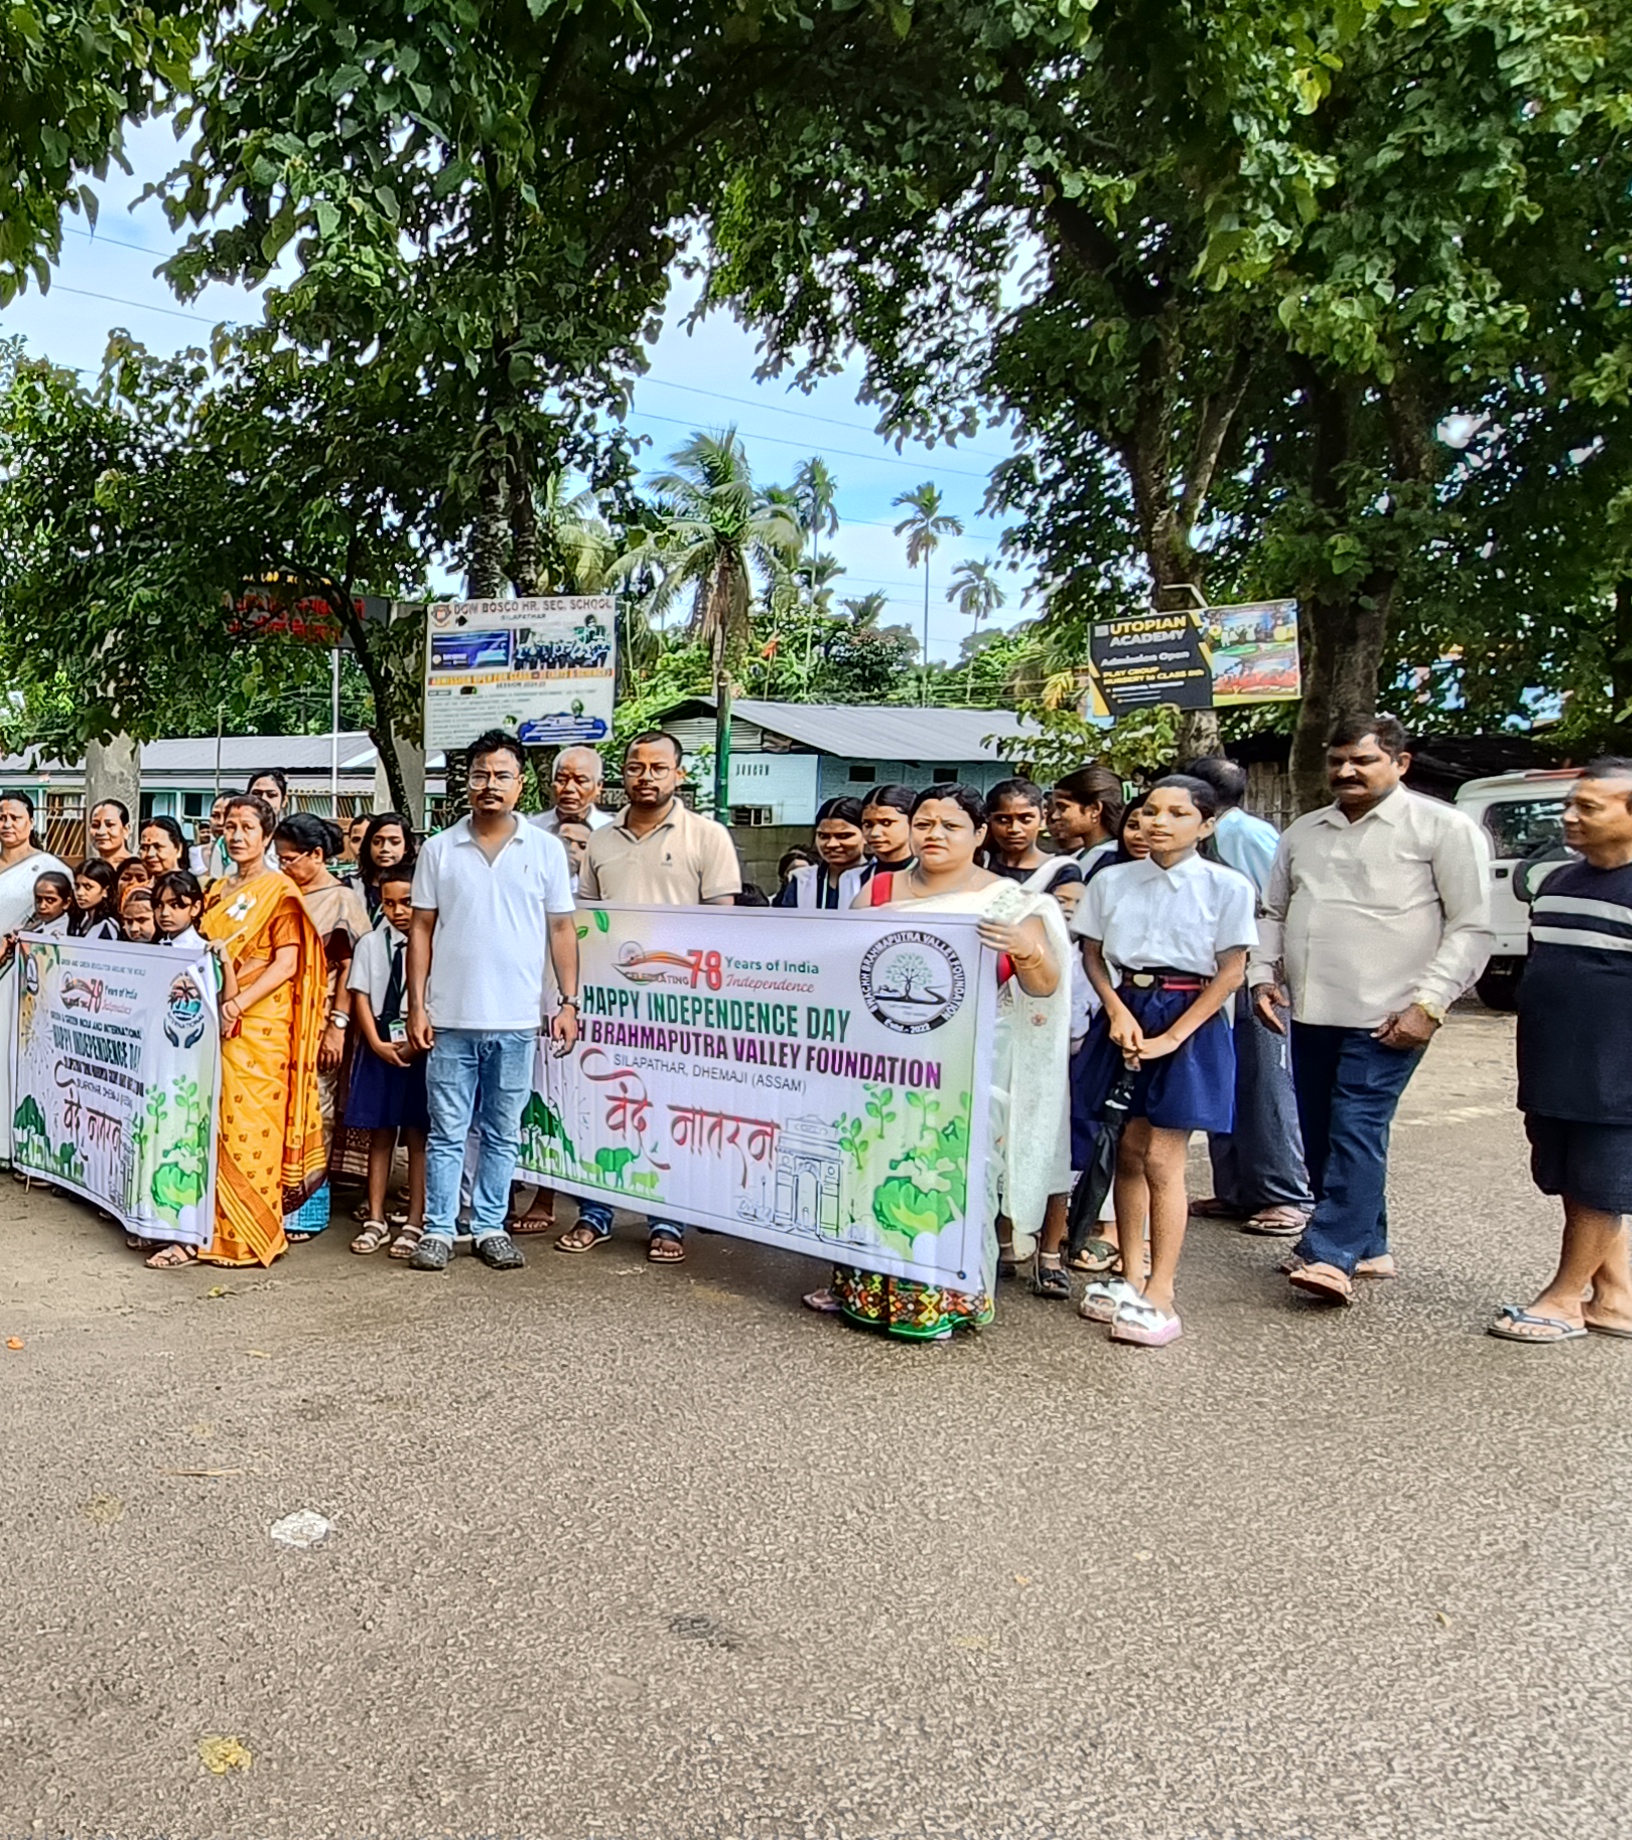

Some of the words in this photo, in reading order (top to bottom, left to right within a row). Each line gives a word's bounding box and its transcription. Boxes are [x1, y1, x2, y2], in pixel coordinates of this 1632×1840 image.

[454, 602, 479, 615] DON
[482, 601, 519, 613] BOSCO
[523, 601, 539, 611] HR.
[543, 600, 567, 611] SEC.
[570, 598, 612, 610] SCHOOL
[1110, 616, 1186, 635] UTOPIAN
[1109, 629, 1186, 647] ACADEMY
[1100, 653, 1158, 667] Admission
[1159, 651, 1190, 661] Open
[1103, 669, 1127, 678] PLAY
[1128, 666, 1160, 675] GROUP
[1103, 675, 1145, 685] NURSERY
[1157, 670, 1187, 680] CLASS
[686, 949, 723, 991] 78
[725, 956, 762, 971] Years
[766, 959, 780, 972] of
[784, 961, 820, 974] India
[726, 974, 815, 993] Independence
[863, 931, 922, 971] BRAHMAPUTRA
[922, 933, 958, 962] VALLEY
[940, 960, 966, 1021] FOUNDATION
[87, 978, 103, 1014] 78
[582, 985, 640, 1020] HAPPY
[646, 992, 798, 1038] INDEPENDENCE
[806, 1006, 851, 1043] DAY
[72, 1030, 128, 1069] INDEPENDENCE
[592, 1020, 728, 1060] BRAHMAPUTRA
[732, 1036, 801, 1071] VALLEY
[805, 1046, 942, 1090] FOUNDATION
[614, 1053, 688, 1077] SILAPATHAR,
[693, 1064, 747, 1084] DHEMAJI
[751, 1071, 807, 1096] (ASSAM)
